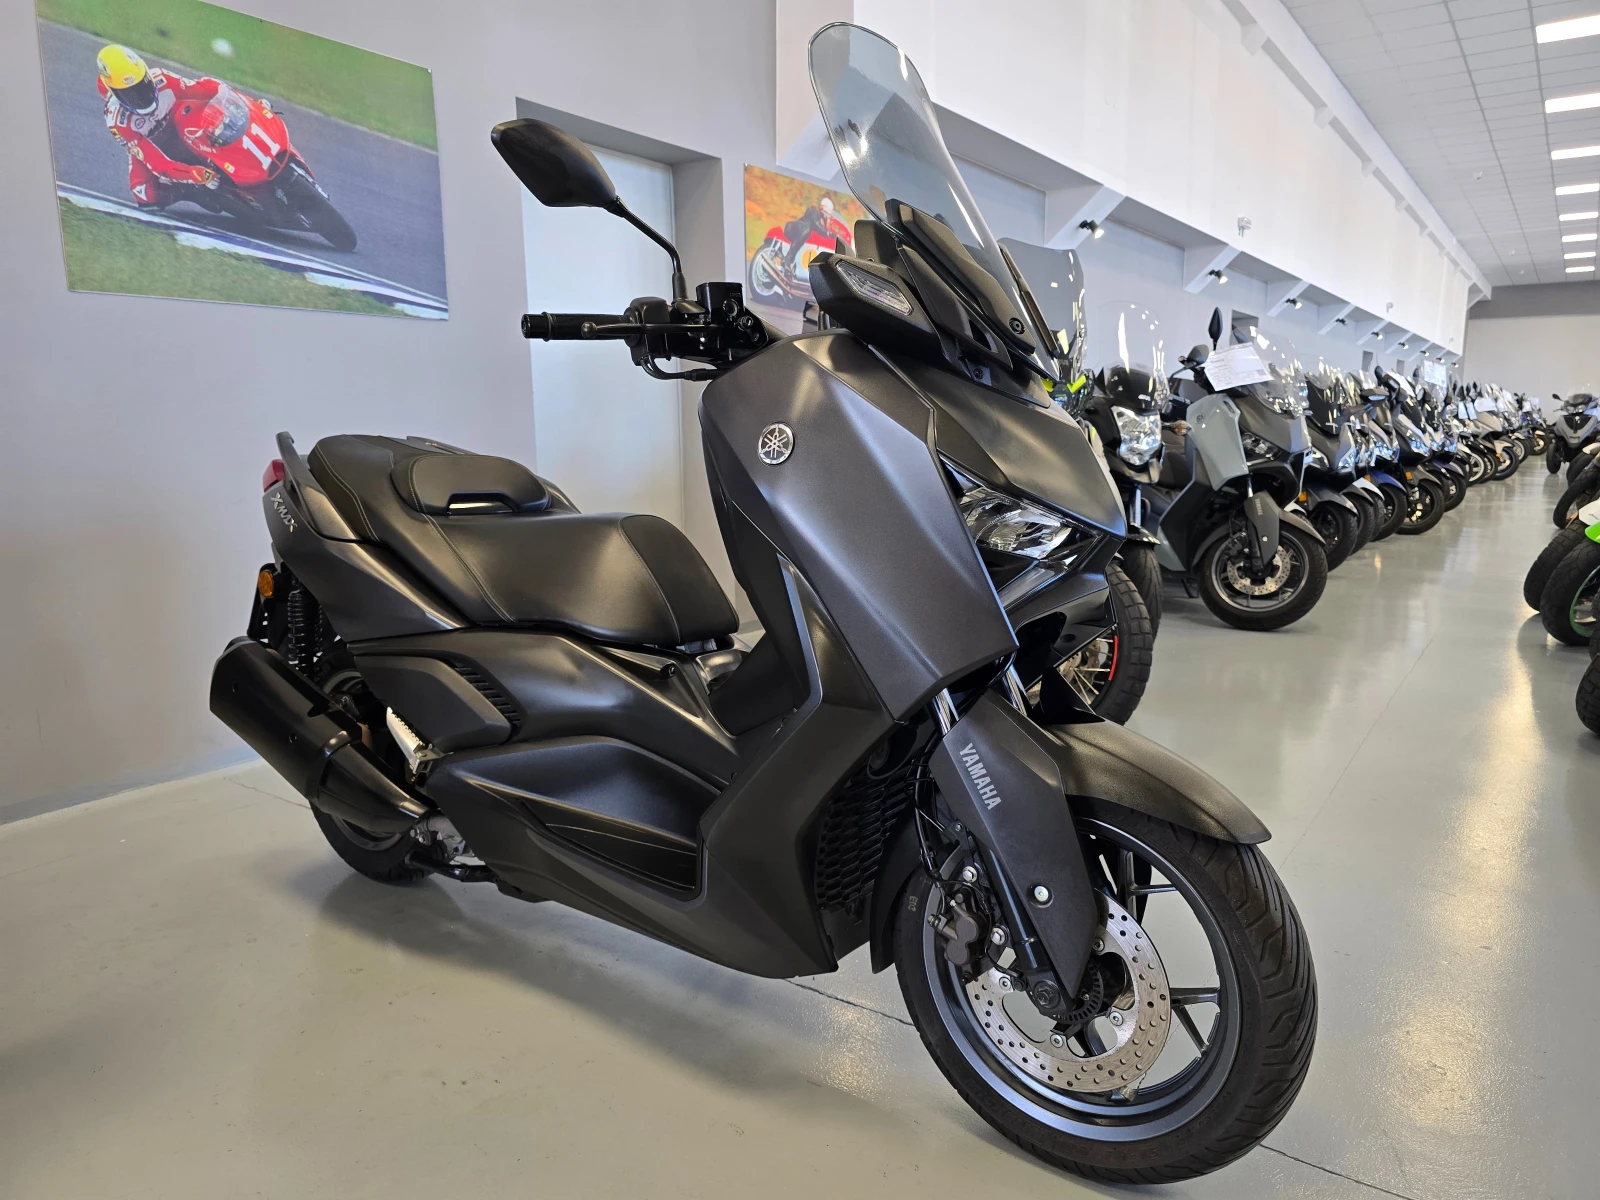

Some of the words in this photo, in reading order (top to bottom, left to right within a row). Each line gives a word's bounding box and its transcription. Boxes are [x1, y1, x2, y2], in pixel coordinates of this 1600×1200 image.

[242, 122, 281, 171] 11
[270, 491, 298, 533] XMAX
[959, 742, 1002, 811] YAMAHA
